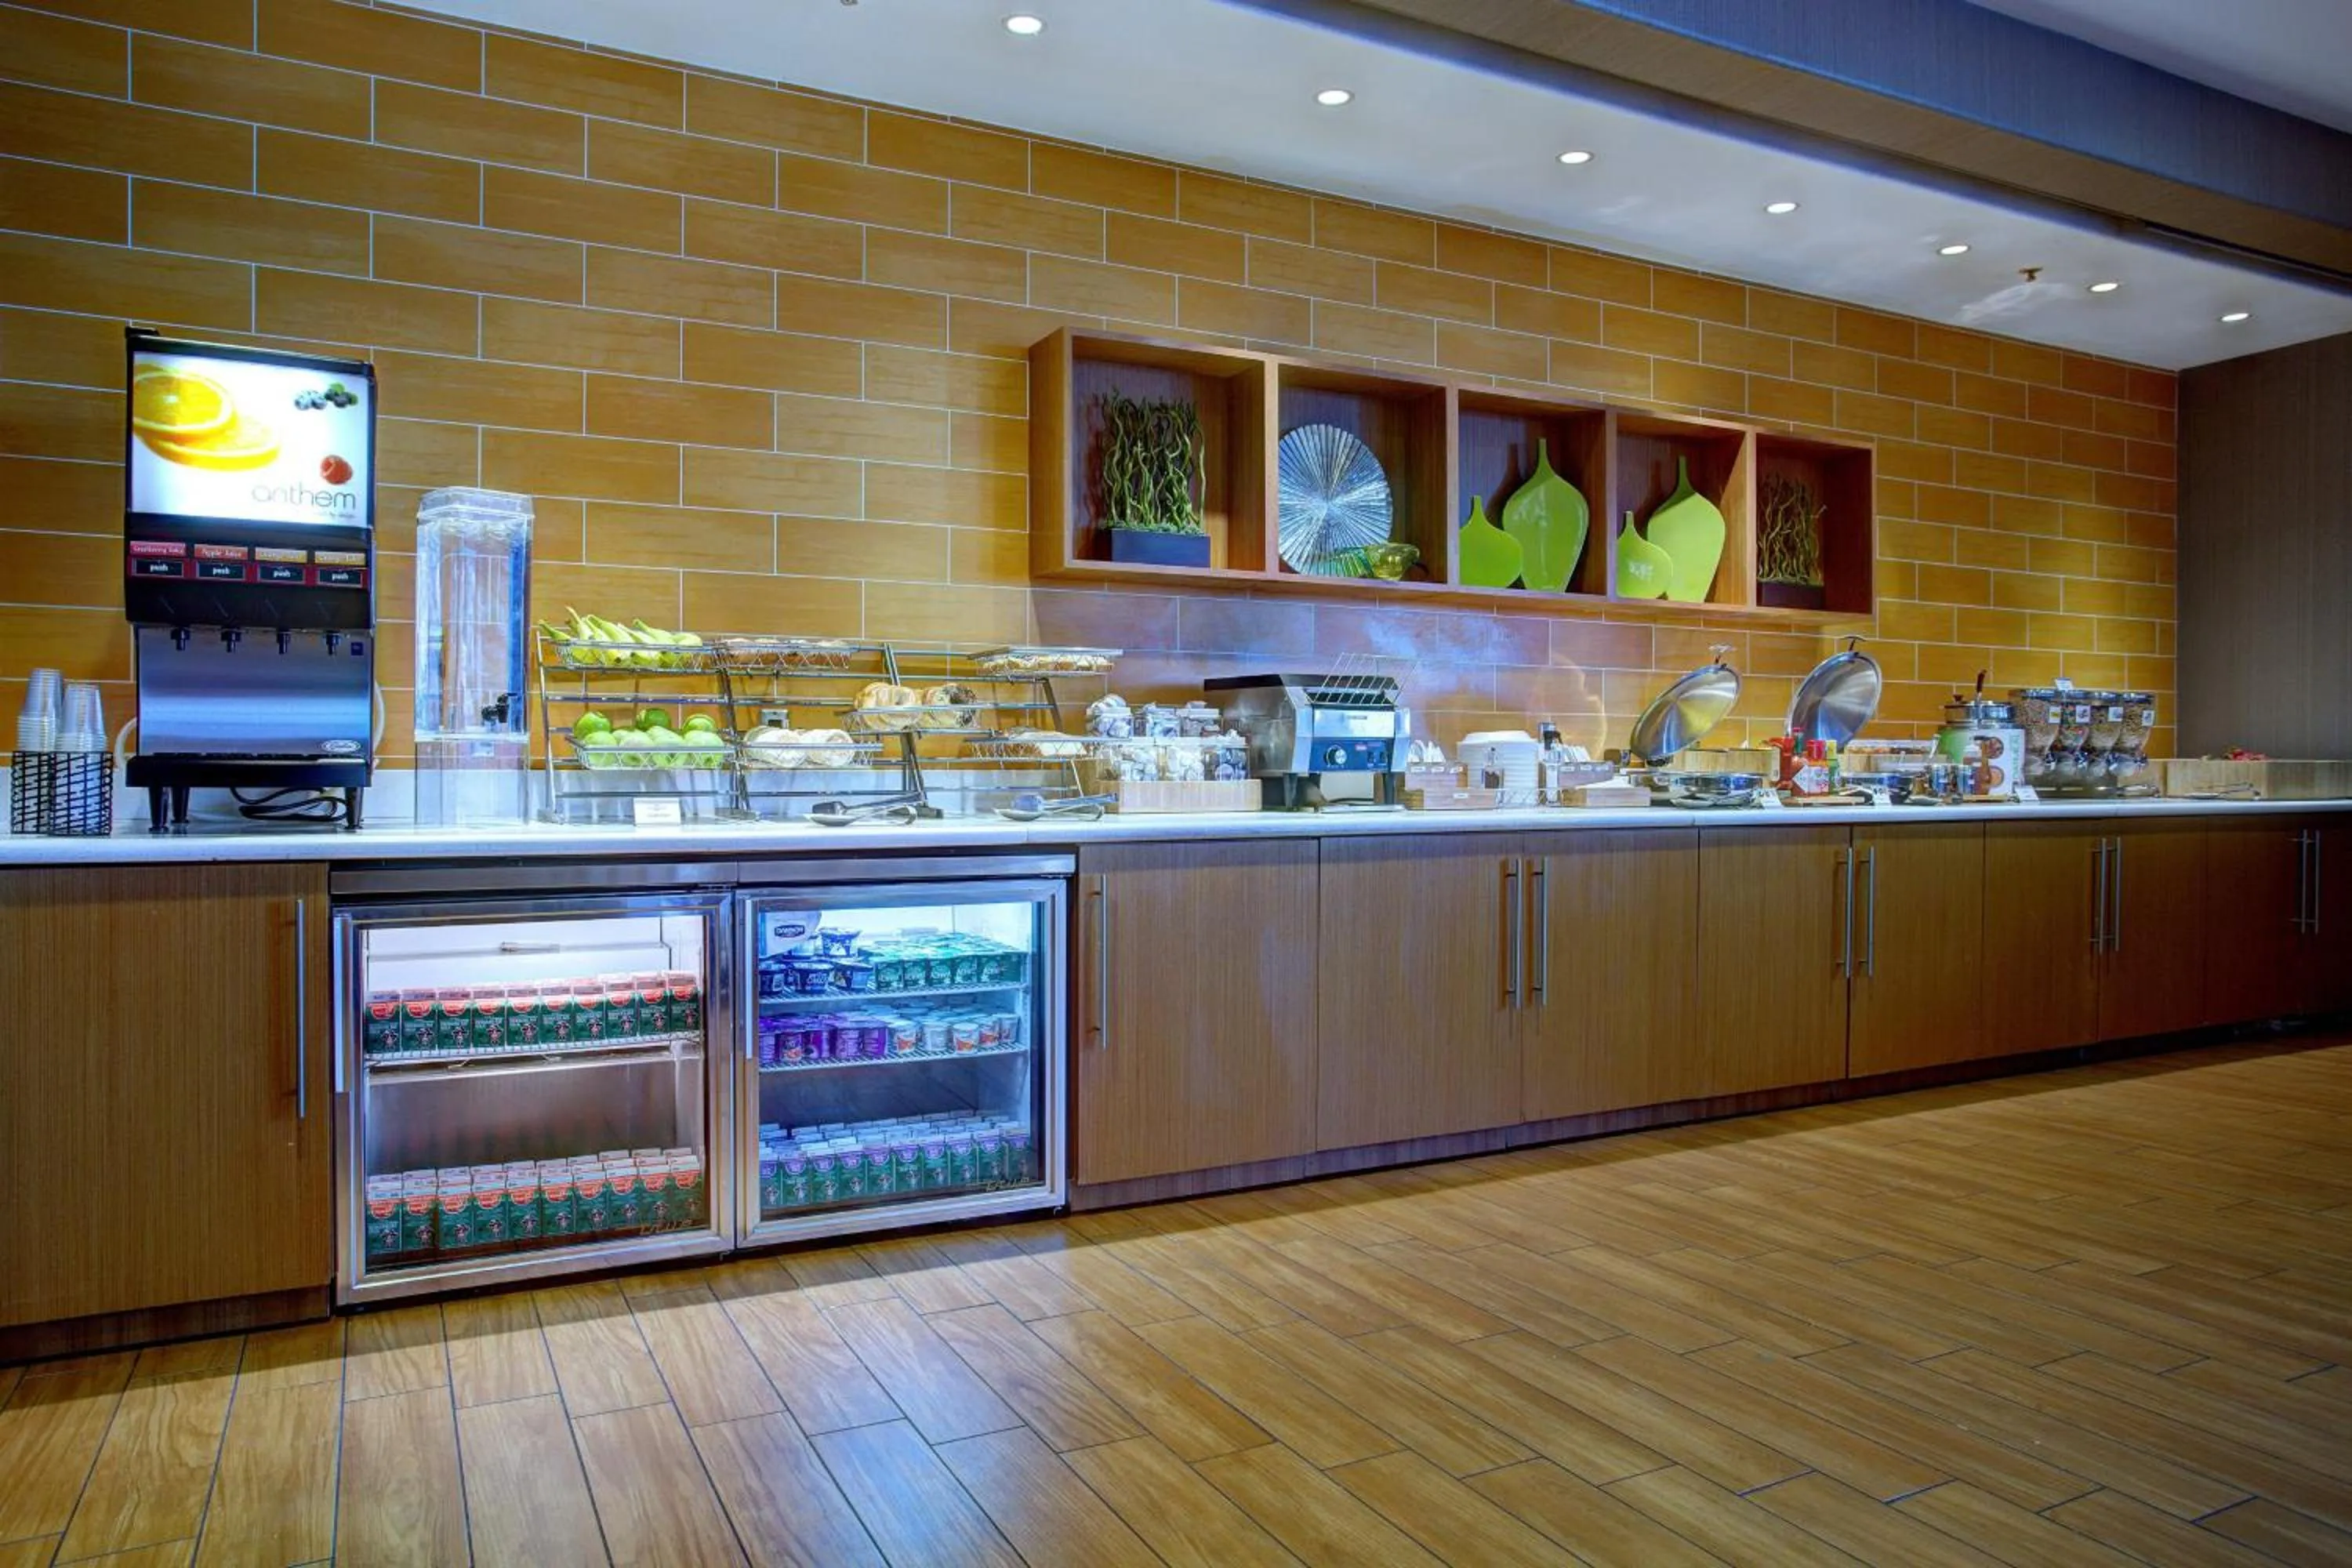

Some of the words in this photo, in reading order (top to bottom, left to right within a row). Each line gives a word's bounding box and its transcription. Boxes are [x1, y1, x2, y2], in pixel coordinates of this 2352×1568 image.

[252, 481, 356, 510] anthem
[150, 564, 169, 573] push
[212, 566, 230, 575] push
[273, 569, 291, 578] push
[332, 572, 349, 581] push
